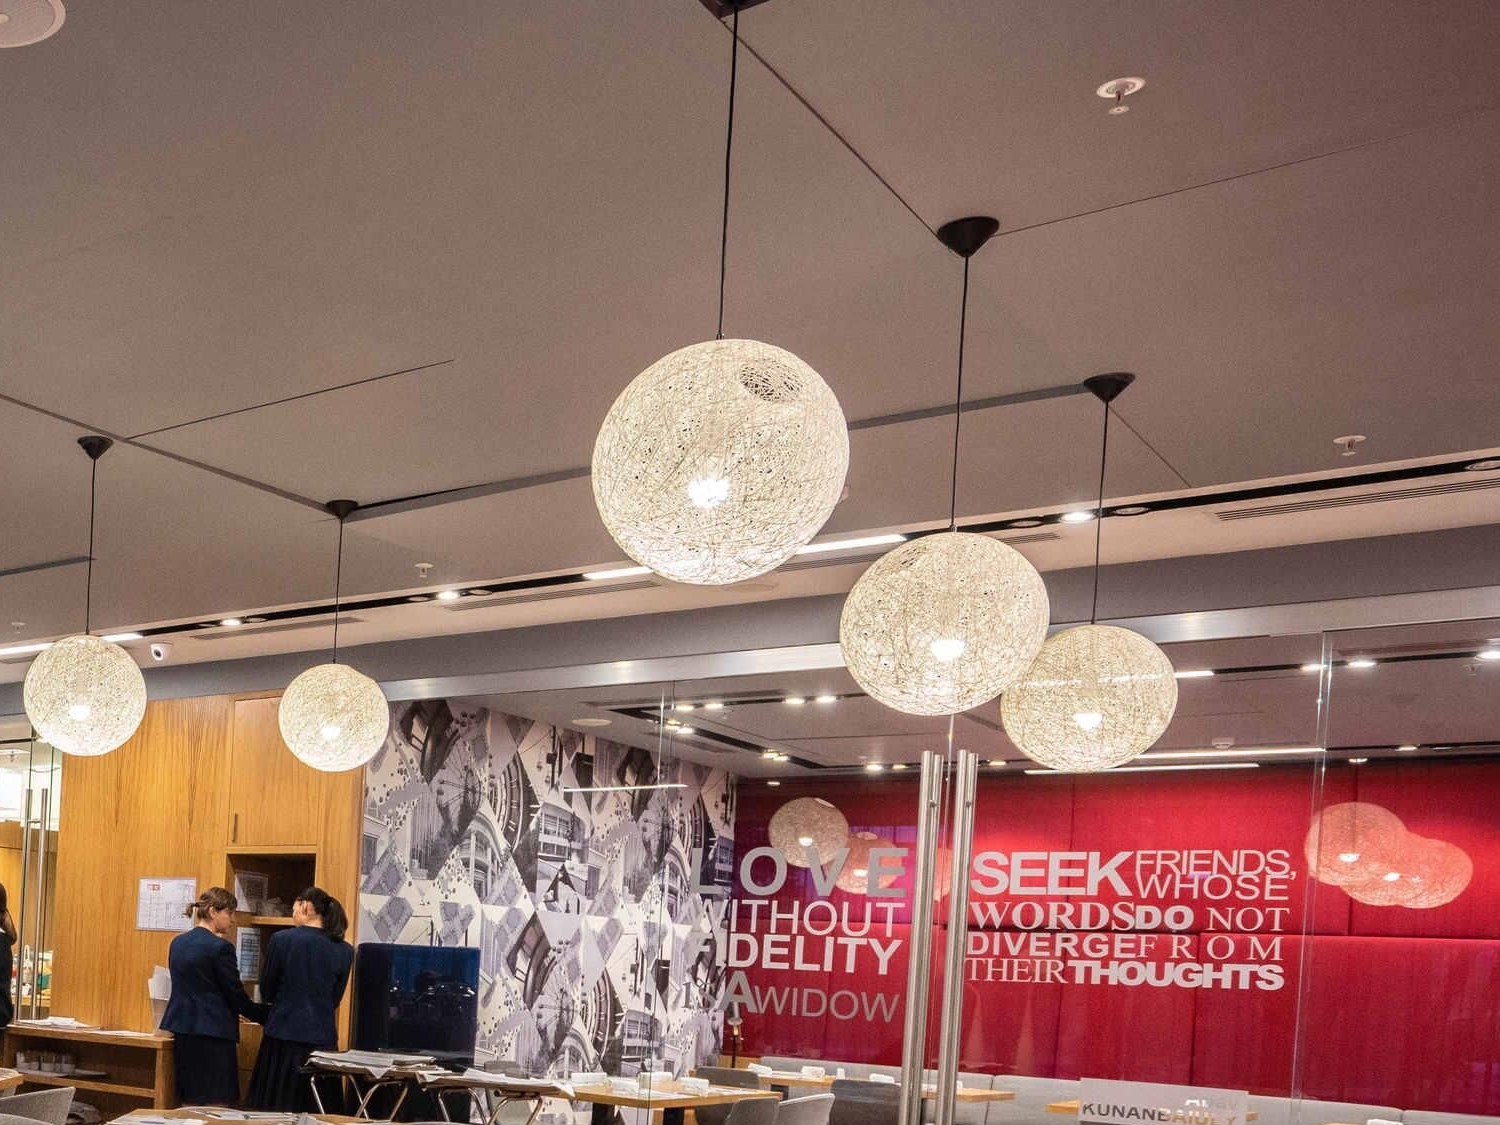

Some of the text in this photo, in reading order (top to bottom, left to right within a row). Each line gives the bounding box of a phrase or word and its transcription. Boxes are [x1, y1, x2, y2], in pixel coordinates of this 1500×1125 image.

[690, 846, 909, 898] LOVE
[970, 849, 1296, 897] SEEK FRIENDS,
[1135, 873, 1290, 901] WHOSE
[691, 898, 905, 938] WITHOUT
[969, 901, 1290, 932] WORDS DO NOT
[966, 932, 1285, 961] DIVERGE FROM
[965, 958, 1285, 991] THEIR THOUGHTS
[719, 970, 757, 1014] A
[755, 986, 900, 1023] WIDOW
